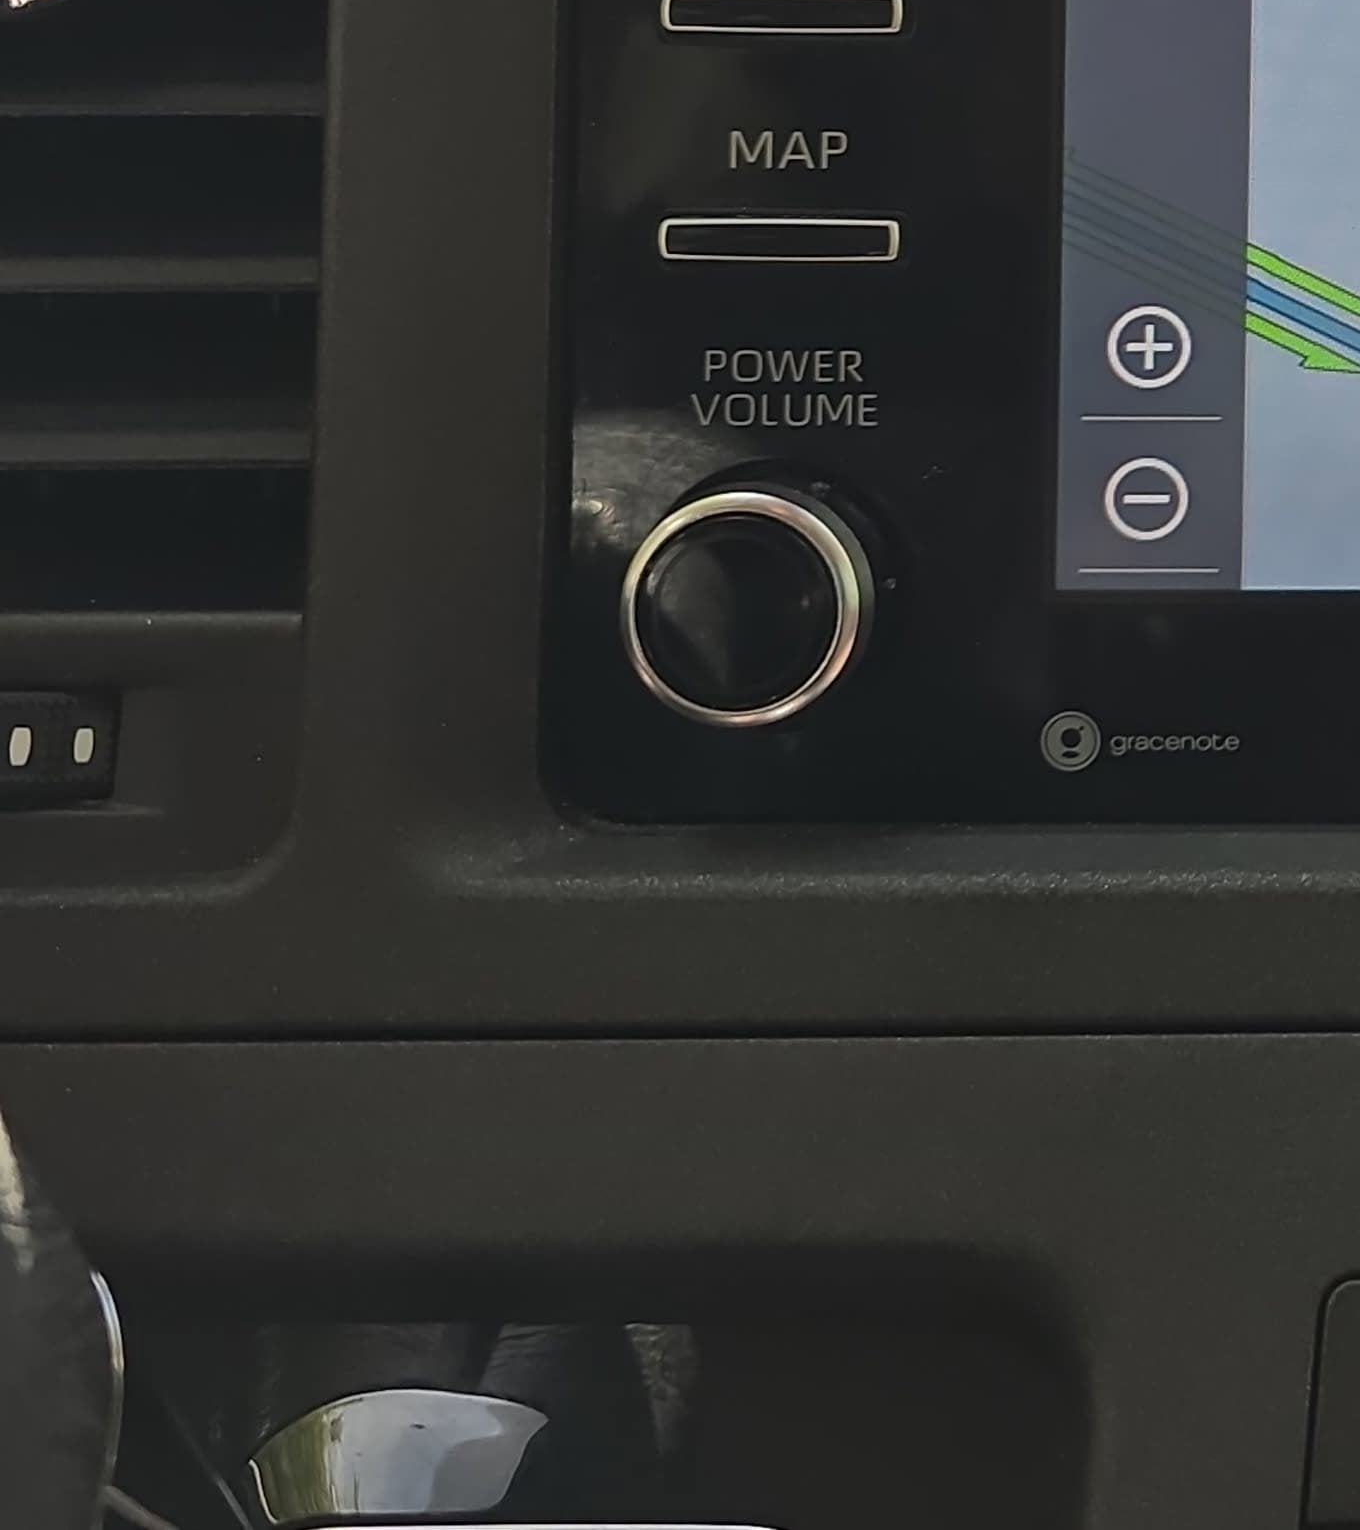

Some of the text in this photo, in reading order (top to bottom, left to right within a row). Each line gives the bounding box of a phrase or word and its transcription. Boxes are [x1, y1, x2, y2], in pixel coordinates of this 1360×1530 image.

[728, 130, 850, 171] MAP
[703, 348, 864, 384] POWER
[692, 392, 879, 428] VOLUME
[1109, 733, 1241, 757] gracenote
